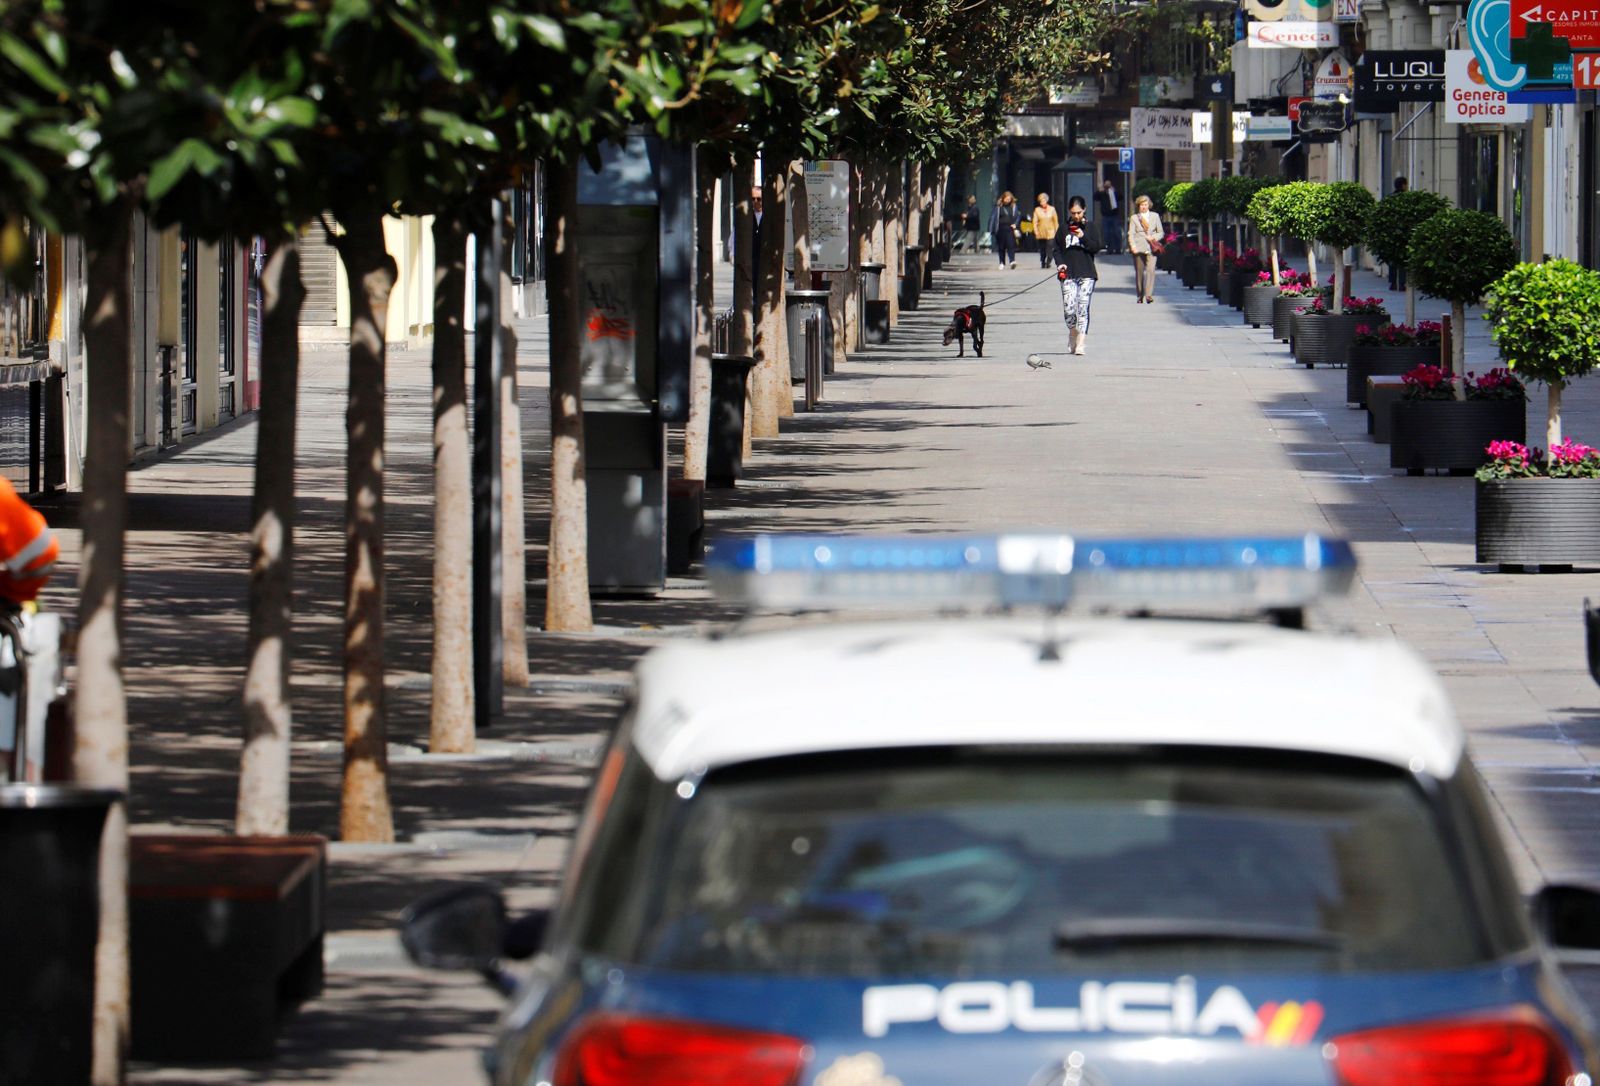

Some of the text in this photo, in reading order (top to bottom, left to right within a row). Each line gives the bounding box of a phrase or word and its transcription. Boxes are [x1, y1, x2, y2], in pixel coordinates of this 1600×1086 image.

[1457, 102, 1506, 118] Optica
[1121, 150, 1132, 163] P
[862, 974, 1264, 1038] POLICÍA
